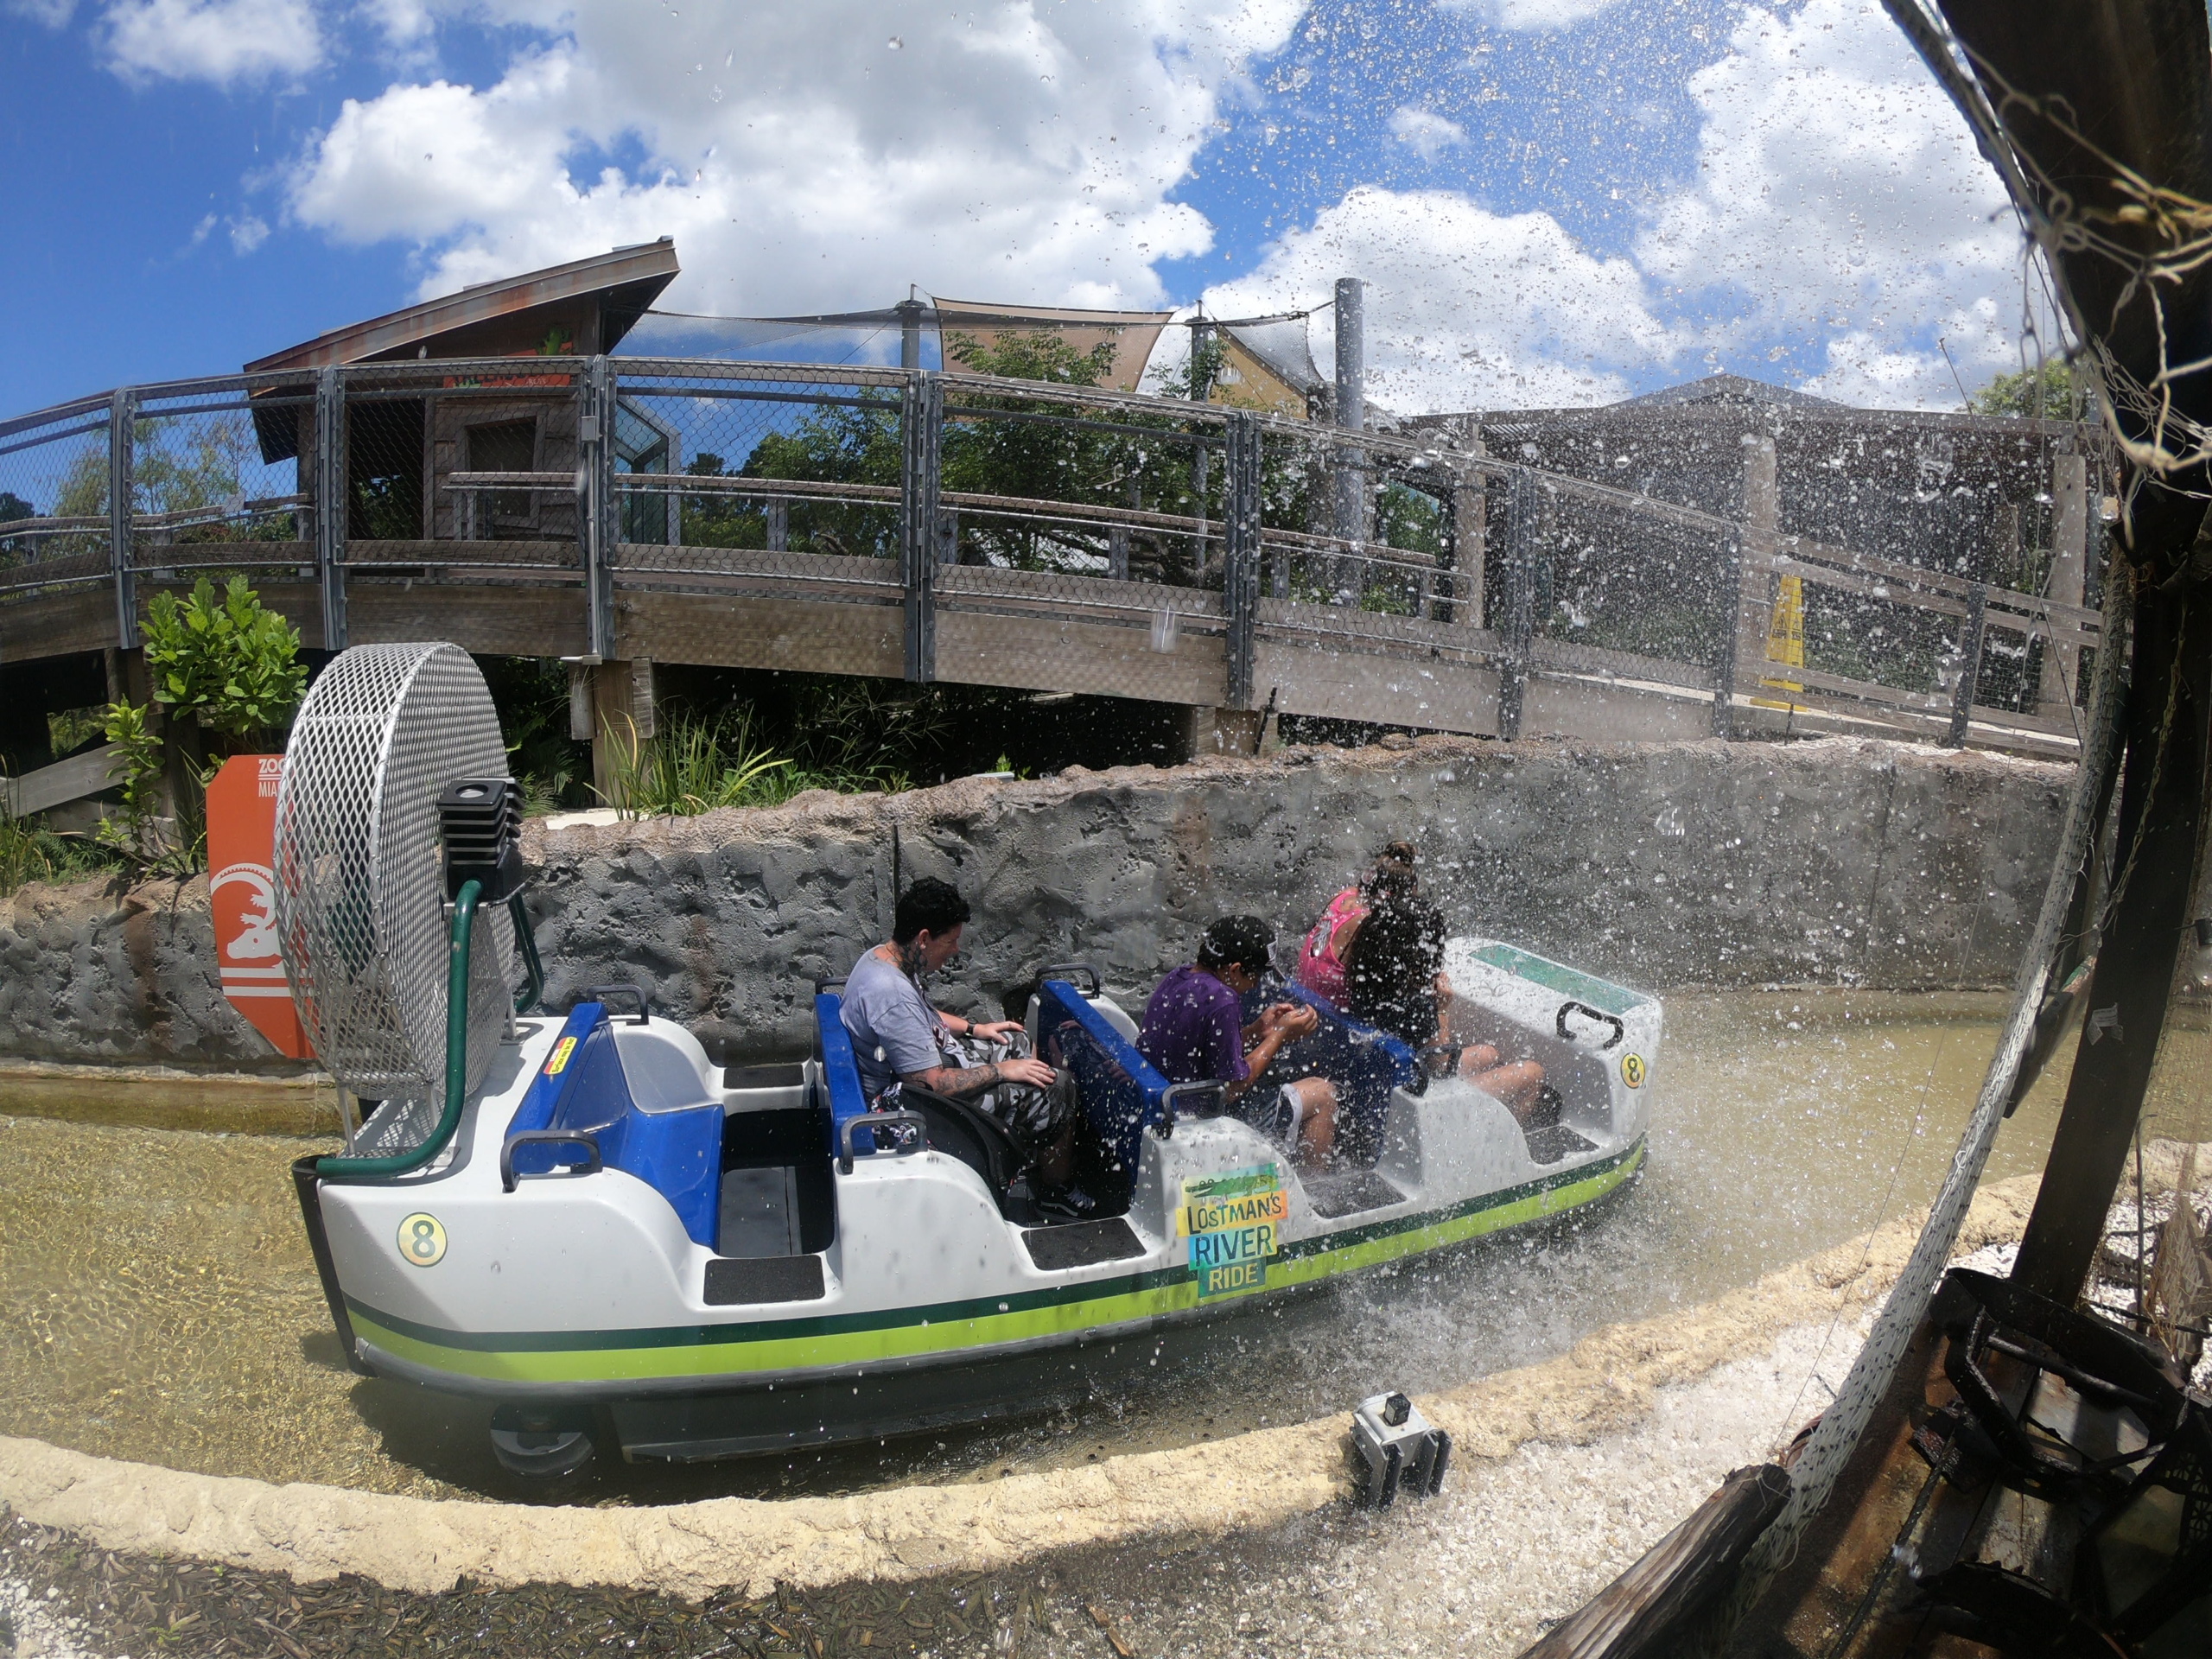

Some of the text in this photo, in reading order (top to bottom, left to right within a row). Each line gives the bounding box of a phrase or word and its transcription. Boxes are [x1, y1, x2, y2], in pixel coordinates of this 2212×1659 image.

[258, 781, 281, 797] MIA
[1627, 1057, 1641, 1083] 8
[412, 1220, 435, 1258] 8
[1196, 1225, 1273, 1267] RIVER
[1209, 1263, 1258, 1291] RIDE
